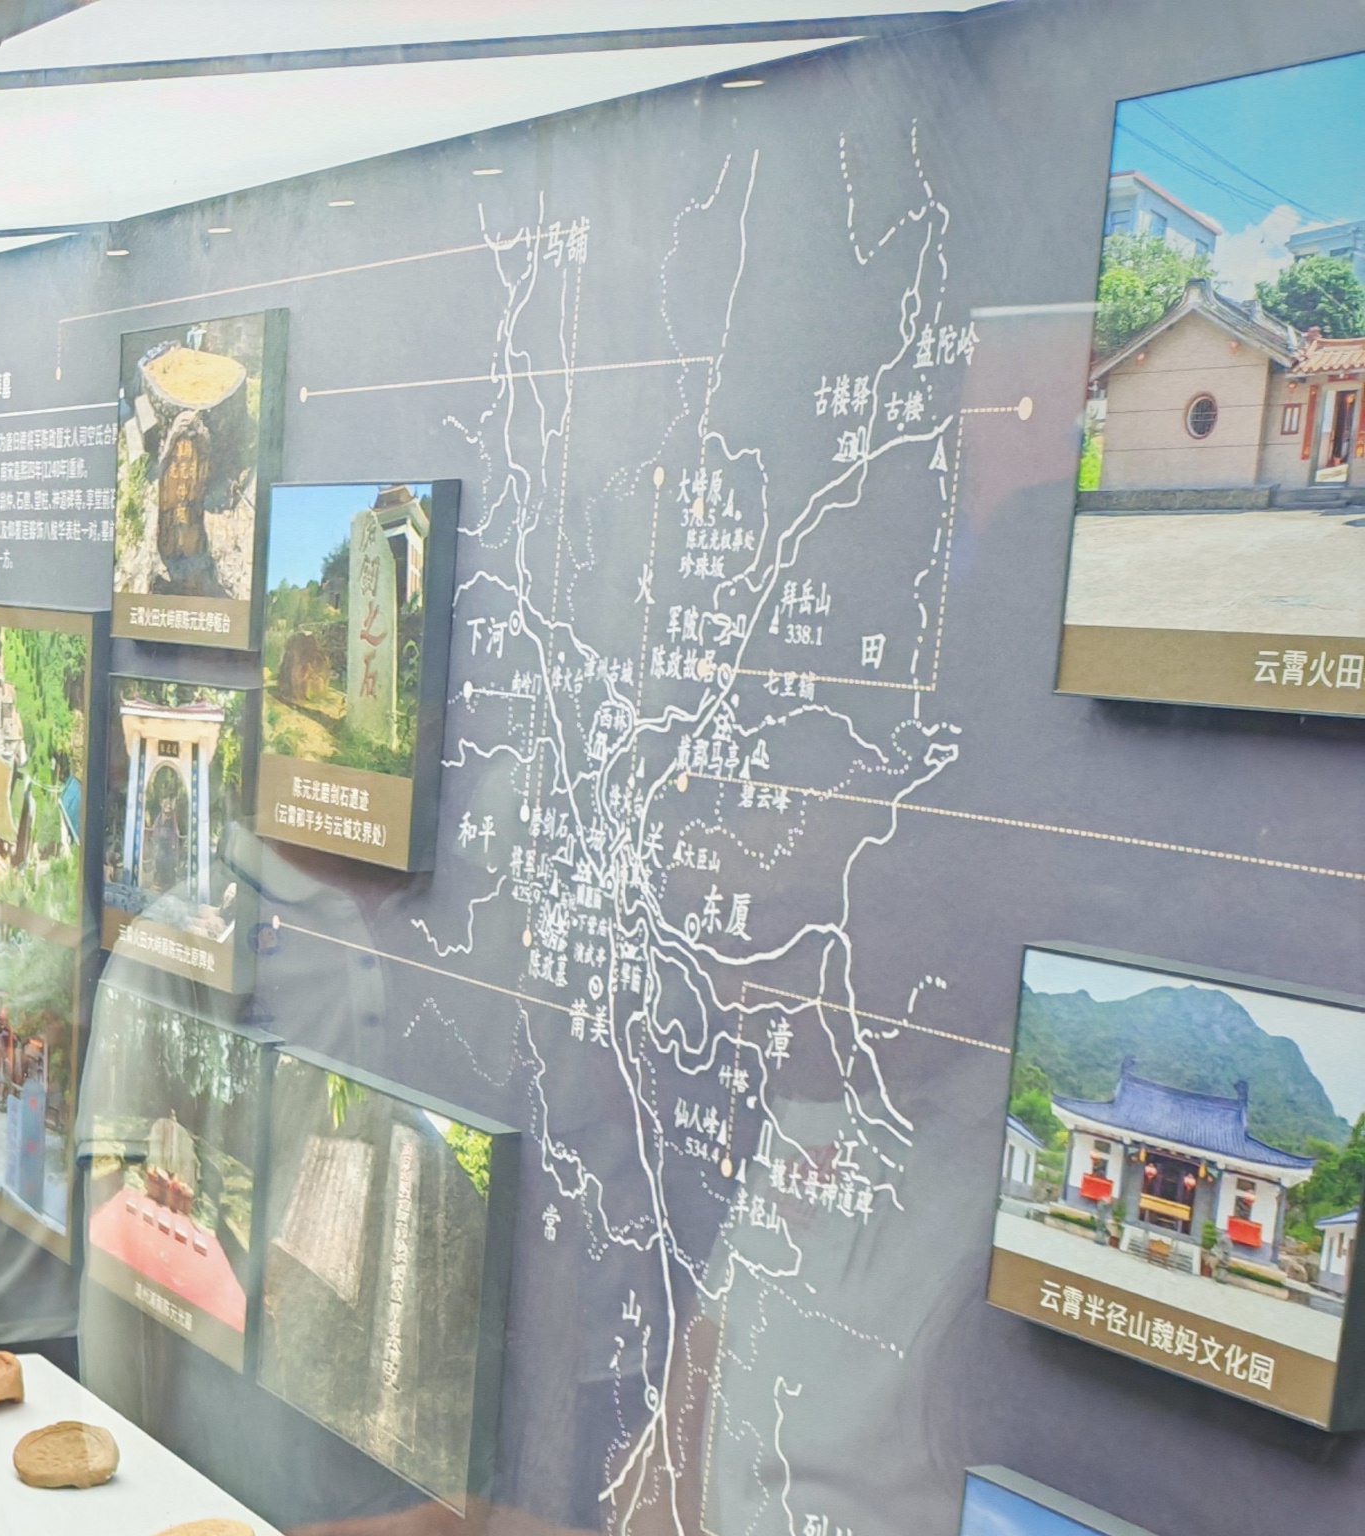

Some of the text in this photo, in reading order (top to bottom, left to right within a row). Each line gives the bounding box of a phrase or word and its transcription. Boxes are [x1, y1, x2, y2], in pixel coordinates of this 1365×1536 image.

[912, 321, 981, 369] 盘陀岭
[884, 390, 925, 423] 古楼
[466, 617, 508, 659] 下河
[634, 565, 886, 670] 火 田
[784, 624, 824, 646] 338.1
[1253, 648, 1365, 691] 云霄火田
[457, 811, 497, 853] 和平
[700, 882, 752, 943] 东厦
[763, 1016, 795, 1070] 漳
[684, 1136, 720, 1164] 534.4
[540, 1202, 644, 1328] 常 山
[1038, 1277, 1277, 1392] 云霄半径山魏妈文化园
